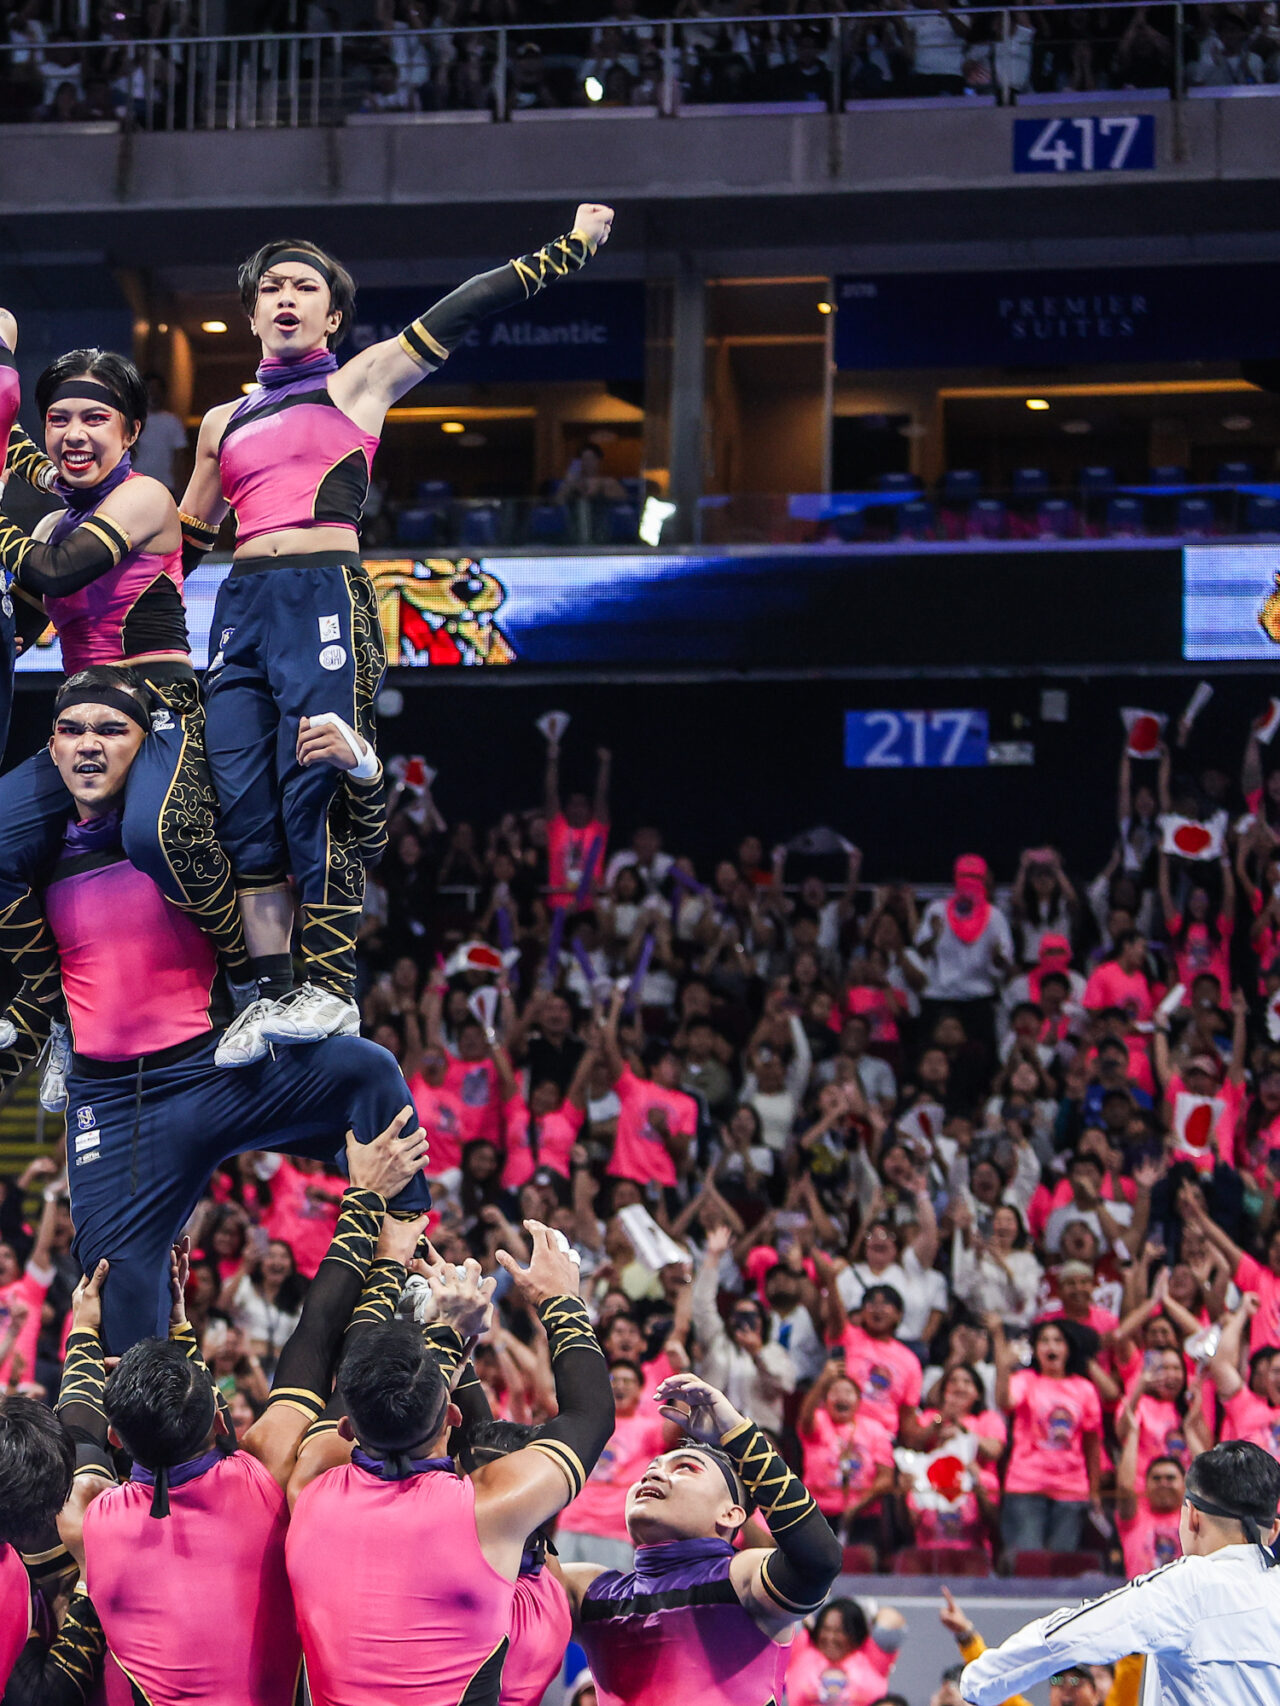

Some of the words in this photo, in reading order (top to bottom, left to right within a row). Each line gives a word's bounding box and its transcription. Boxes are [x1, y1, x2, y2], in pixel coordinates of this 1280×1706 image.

[1028, 116, 1140, 171] 417
[999, 295, 1148, 317] PREMIER
[491, 321, 608, 345] Atlantic
[1012, 317, 1133, 339] SUITES
[865, 711, 971, 767] 217
